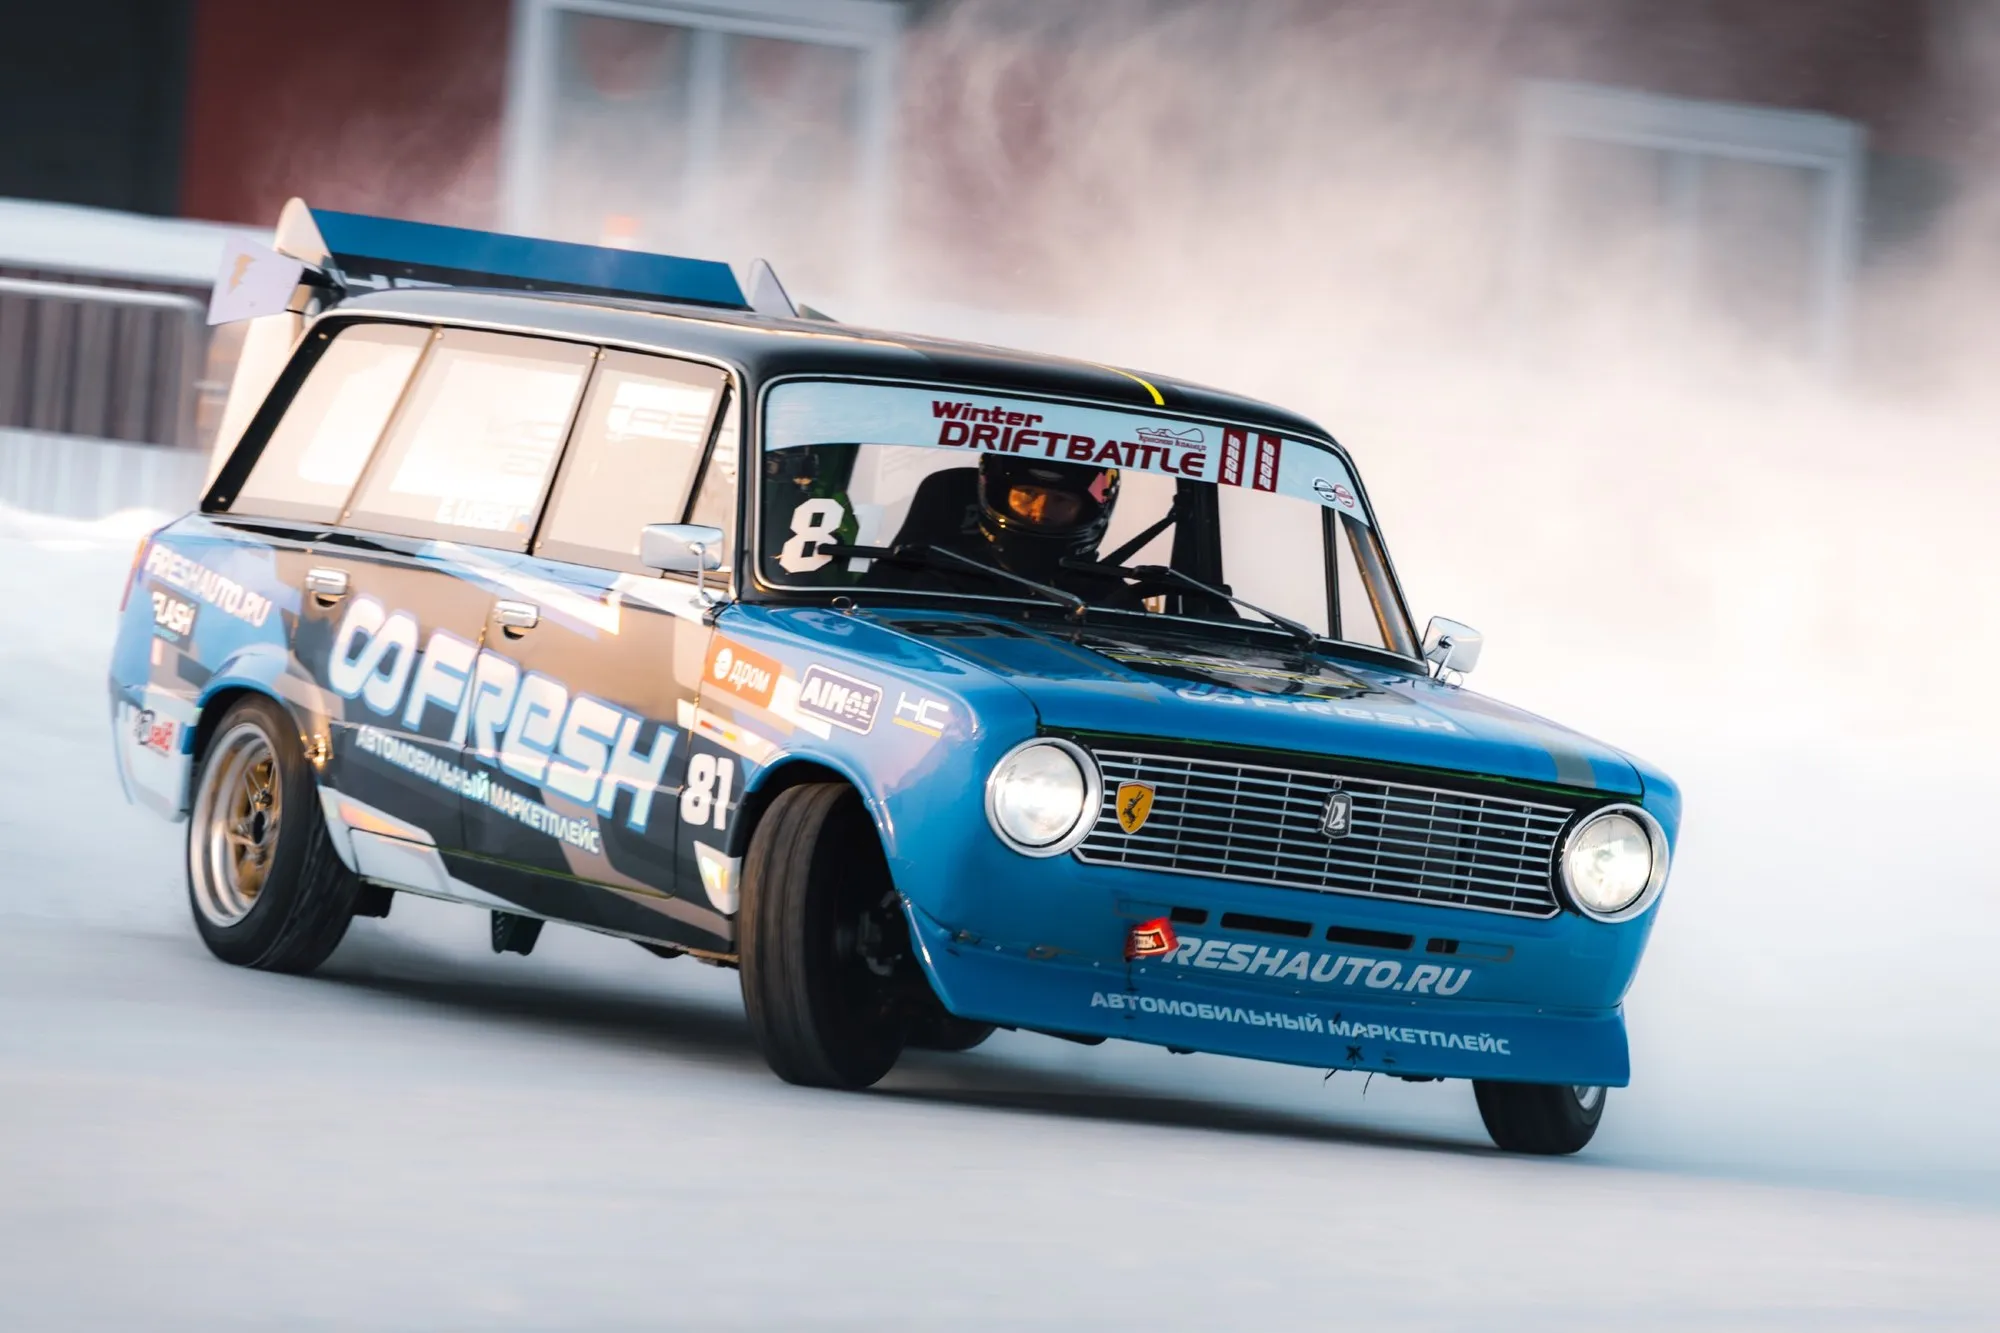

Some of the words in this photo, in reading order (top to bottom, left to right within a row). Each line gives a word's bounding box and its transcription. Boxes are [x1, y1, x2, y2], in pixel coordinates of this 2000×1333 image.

[932, 400, 1043, 428] Winter
[938, 421, 1206, 477] DRIFTBATTLE
[1224, 434, 1241, 484] 2025
[144, 543, 273, 628] FRESHAUTO.RU
[355, 724, 491, 803] АВТОМОБИЛЬНЫЙ
[491, 783, 601, 854] МАРКЕТПЛЕЙС
[679, 752, 734, 831] 81
[1160, 934, 1473, 996] RESHAUTO.RU
[1090, 991, 1324, 1034] АВТОМОБИЛЬНЫЙ
[1329, 1018, 1512, 1055] МАРКЕТПЛЕЙС
